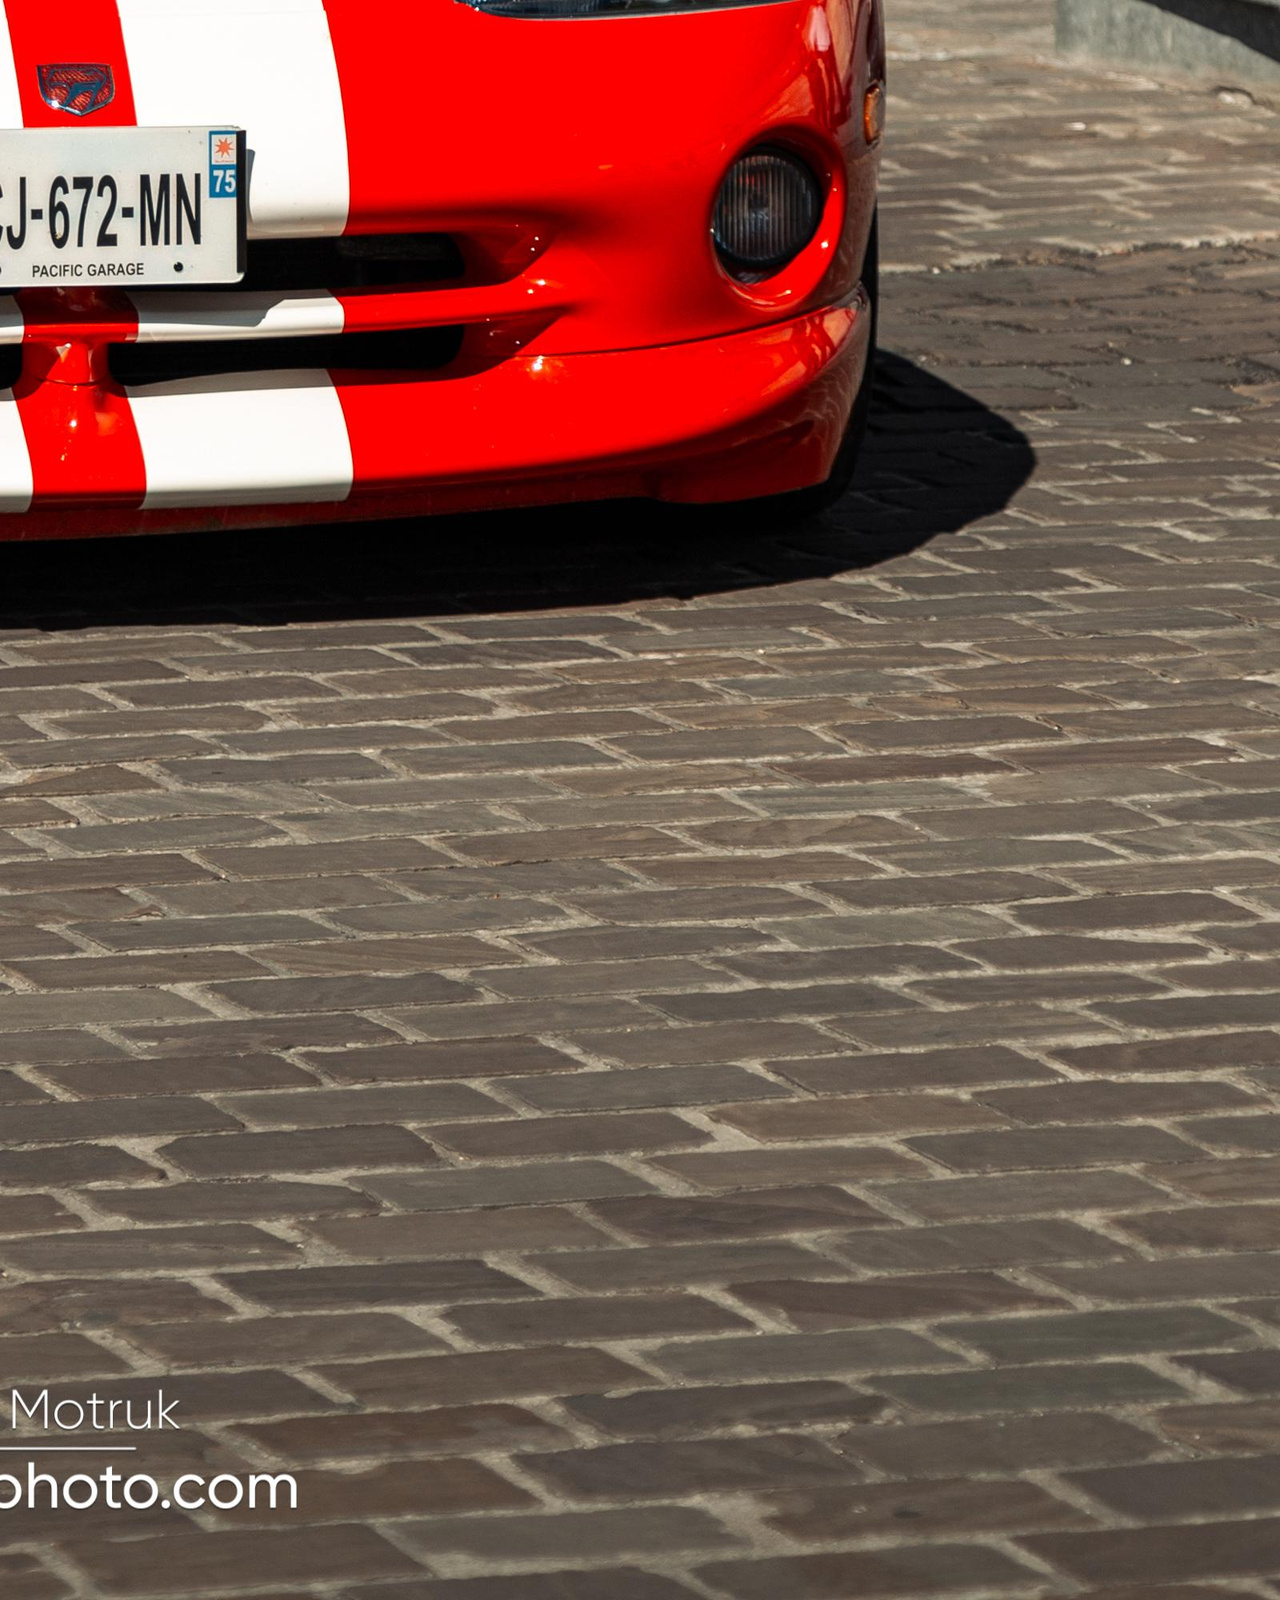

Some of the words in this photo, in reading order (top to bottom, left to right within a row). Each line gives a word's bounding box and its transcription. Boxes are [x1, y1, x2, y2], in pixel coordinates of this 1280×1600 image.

[212, 169, 236, 193] 75
[32, 264, 83, 278] PACIFIC
[87, 262, 145, 277] GARAGE
